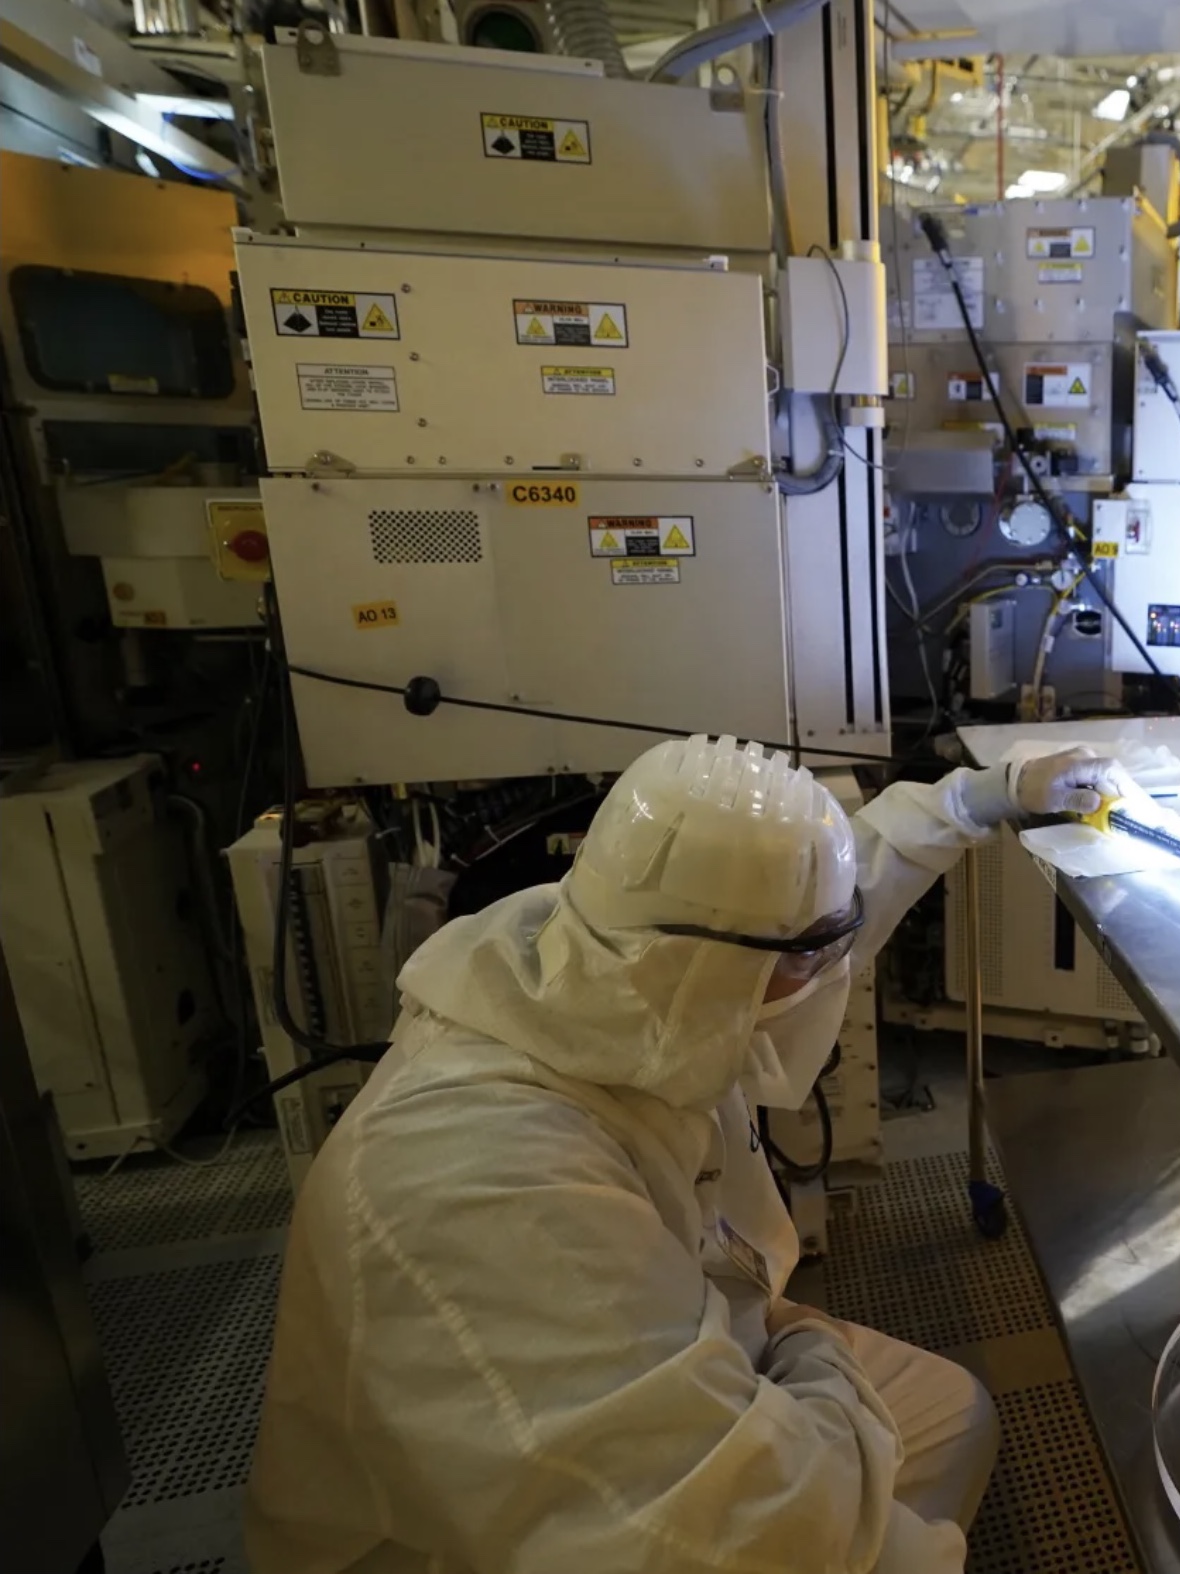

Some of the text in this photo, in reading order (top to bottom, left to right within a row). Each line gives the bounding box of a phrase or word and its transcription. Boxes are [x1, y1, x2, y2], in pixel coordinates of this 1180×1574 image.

[500, 117, 549, 129] CAUTION
[293, 292, 350, 304] CAUTION
[534, 303, 583, 314] WARNING
[513, 485, 576, 502] C6340
[607, 519, 653, 528] WARNING
[359, 607, 396, 624] AO 13
